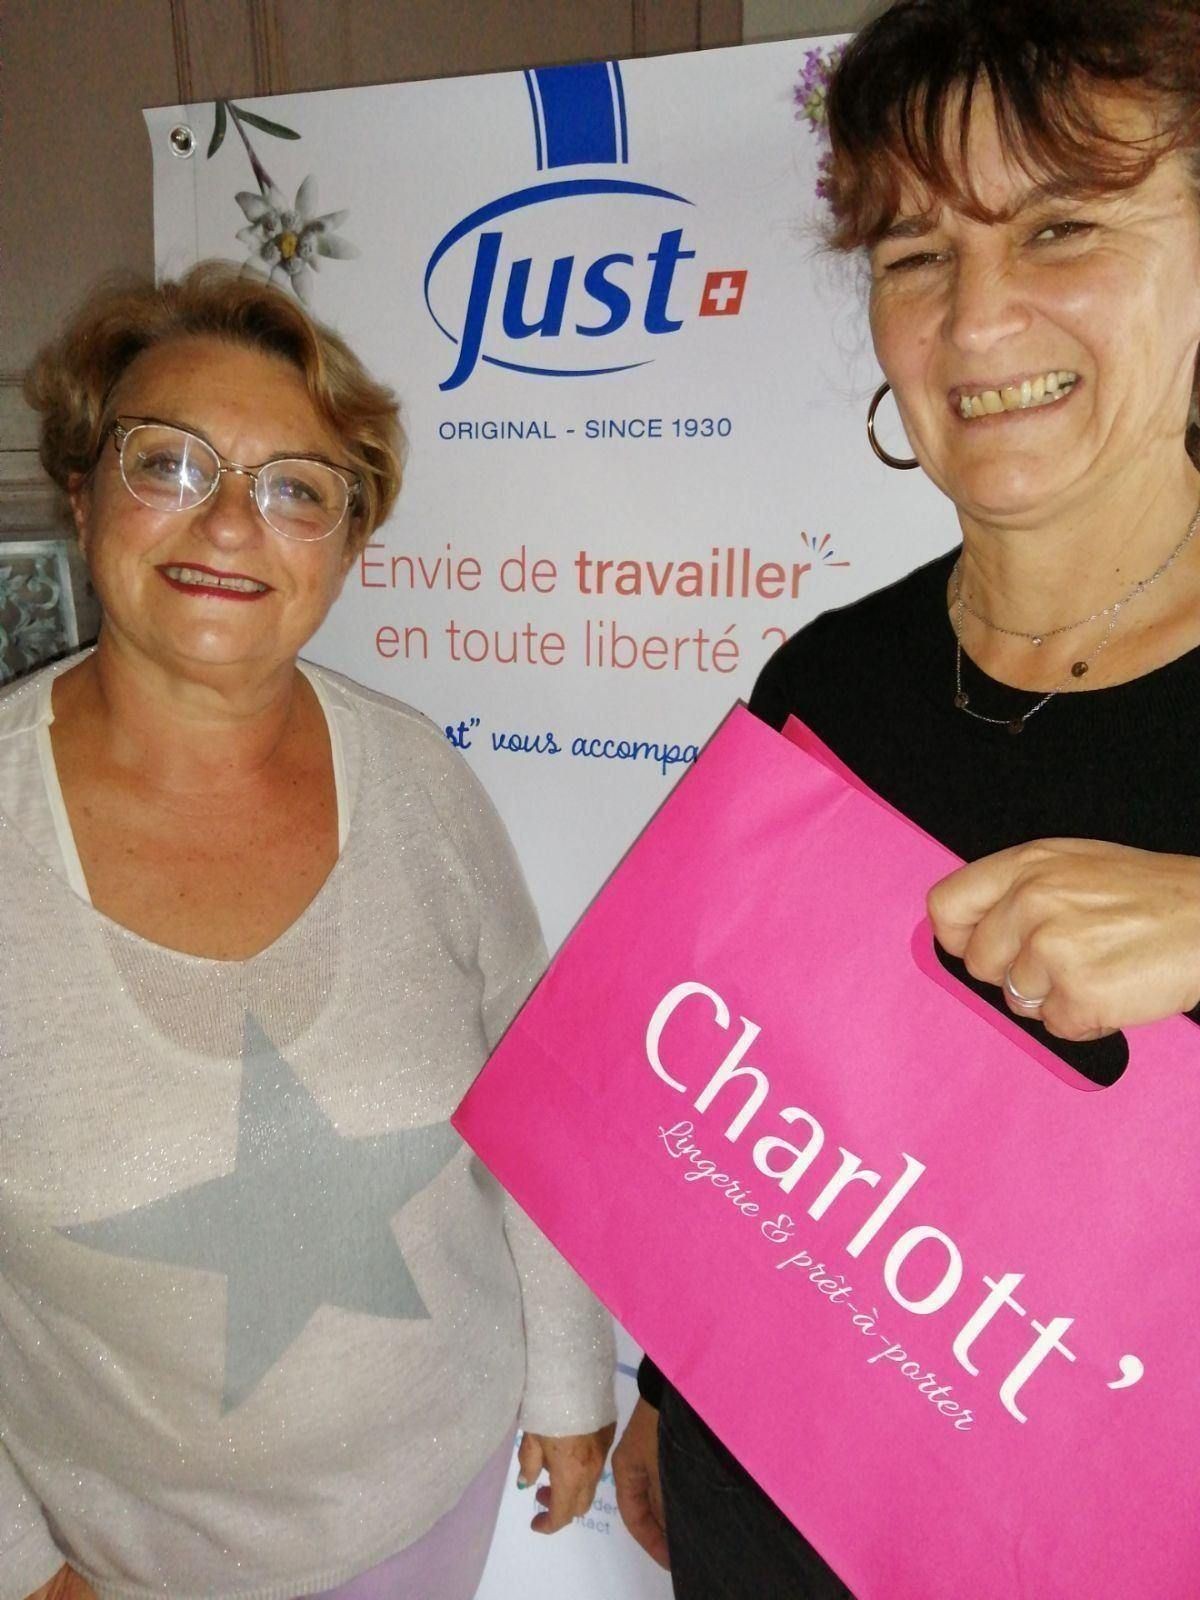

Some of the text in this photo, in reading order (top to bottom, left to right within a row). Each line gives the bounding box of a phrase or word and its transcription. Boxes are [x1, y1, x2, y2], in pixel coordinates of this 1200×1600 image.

[438, 228, 696, 392] Just
[438, 420, 556, 440] ORIGINAL
[585, 418, 662, 438] SINCE
[671, 417, 732, 438] 1930
[361, 543, 811, 600] Envie de travailler
[376, 619, 740, 673] en toute liberté
[492, 732, 562, 755] vous
[658, 1120, 975, 1431] Lingerie & prêt-à-porter
